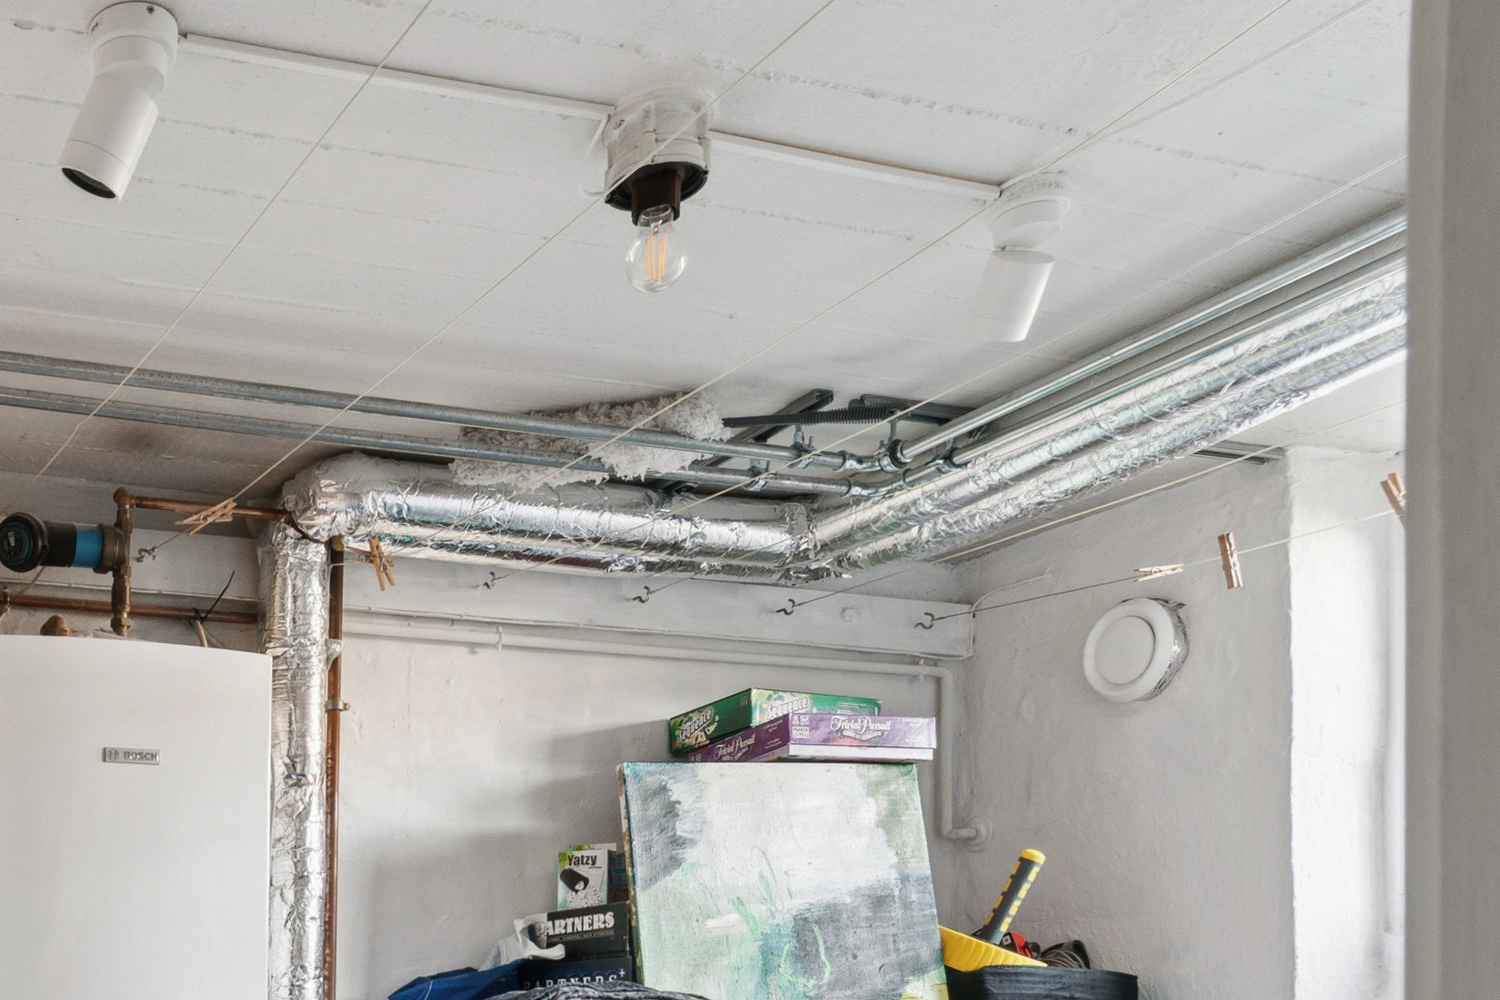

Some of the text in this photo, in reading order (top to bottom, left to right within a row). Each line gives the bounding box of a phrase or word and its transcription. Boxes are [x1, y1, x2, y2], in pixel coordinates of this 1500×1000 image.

[767, 698, 809, 719] Sequence
[678, 708, 713, 742] Sequence
[830, 715, 859, 731] Trivial
[856, 716, 892, 733] Pursuit
[567, 854, 597, 867] Yatzy
[536, 911, 615, 937] PARTNERS
